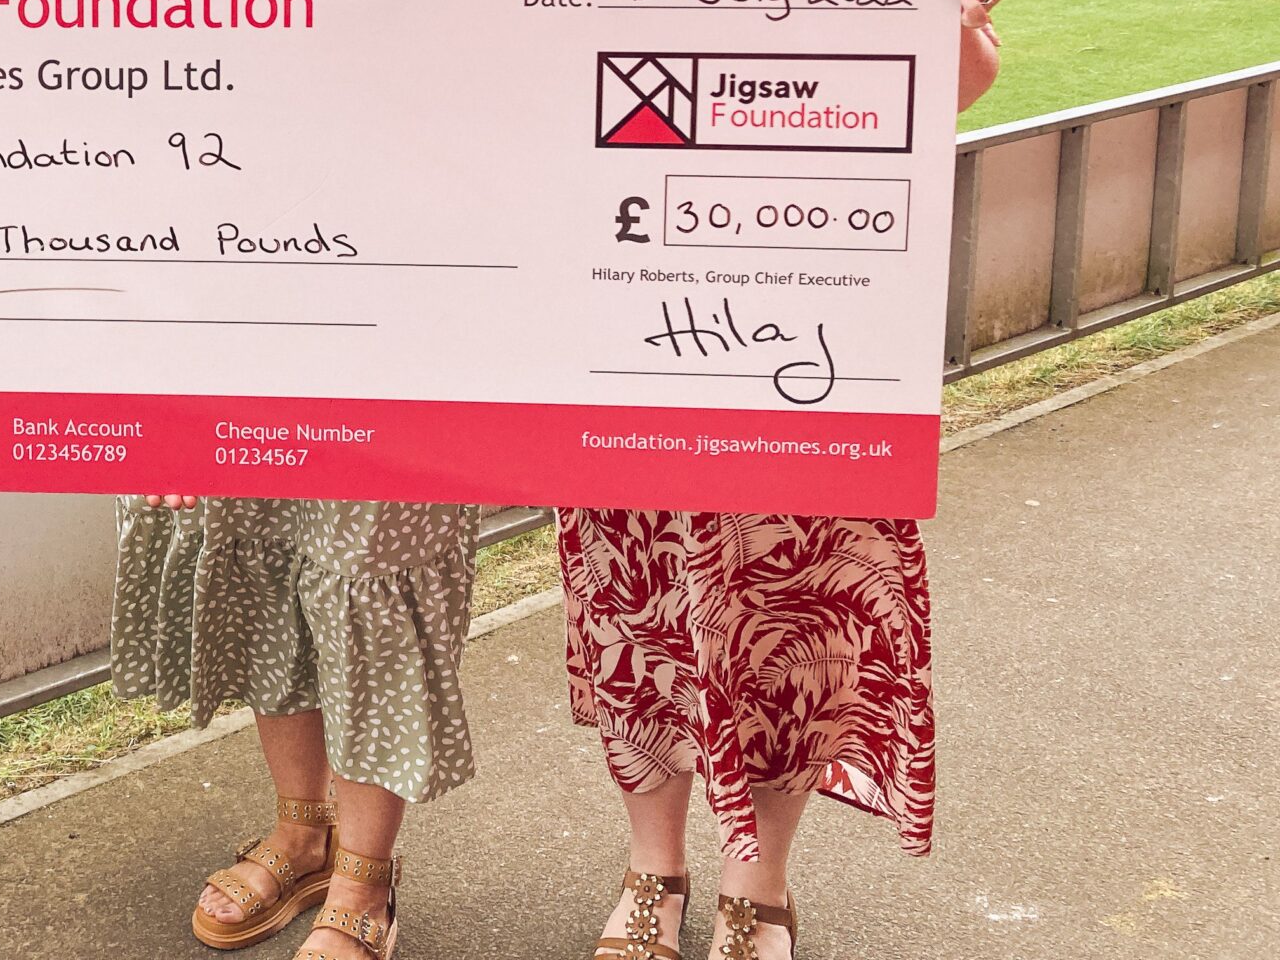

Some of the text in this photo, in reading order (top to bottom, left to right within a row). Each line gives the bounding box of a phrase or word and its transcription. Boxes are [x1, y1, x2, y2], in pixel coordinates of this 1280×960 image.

[38, 59, 148, 99] Group
[163, 59, 234, 91] Ltd.
[710, 73, 819, 104] Jigsaw
[711, 102, 879, 130] Foundation
[168, 132, 242, 170] 92
[216, 222, 358, 258] Pounds
[592, 268, 871, 287] Hilary Roberts, Group Chief Executive
[13, 418, 143, 437] Bank Account
[215, 421, 375, 444] Cheque Number
[12, 443, 127, 462] 0123456789
[215, 447, 308, 466] 01234567
[581, 431, 893, 460] foundation.jigsawhomes.org.uk
